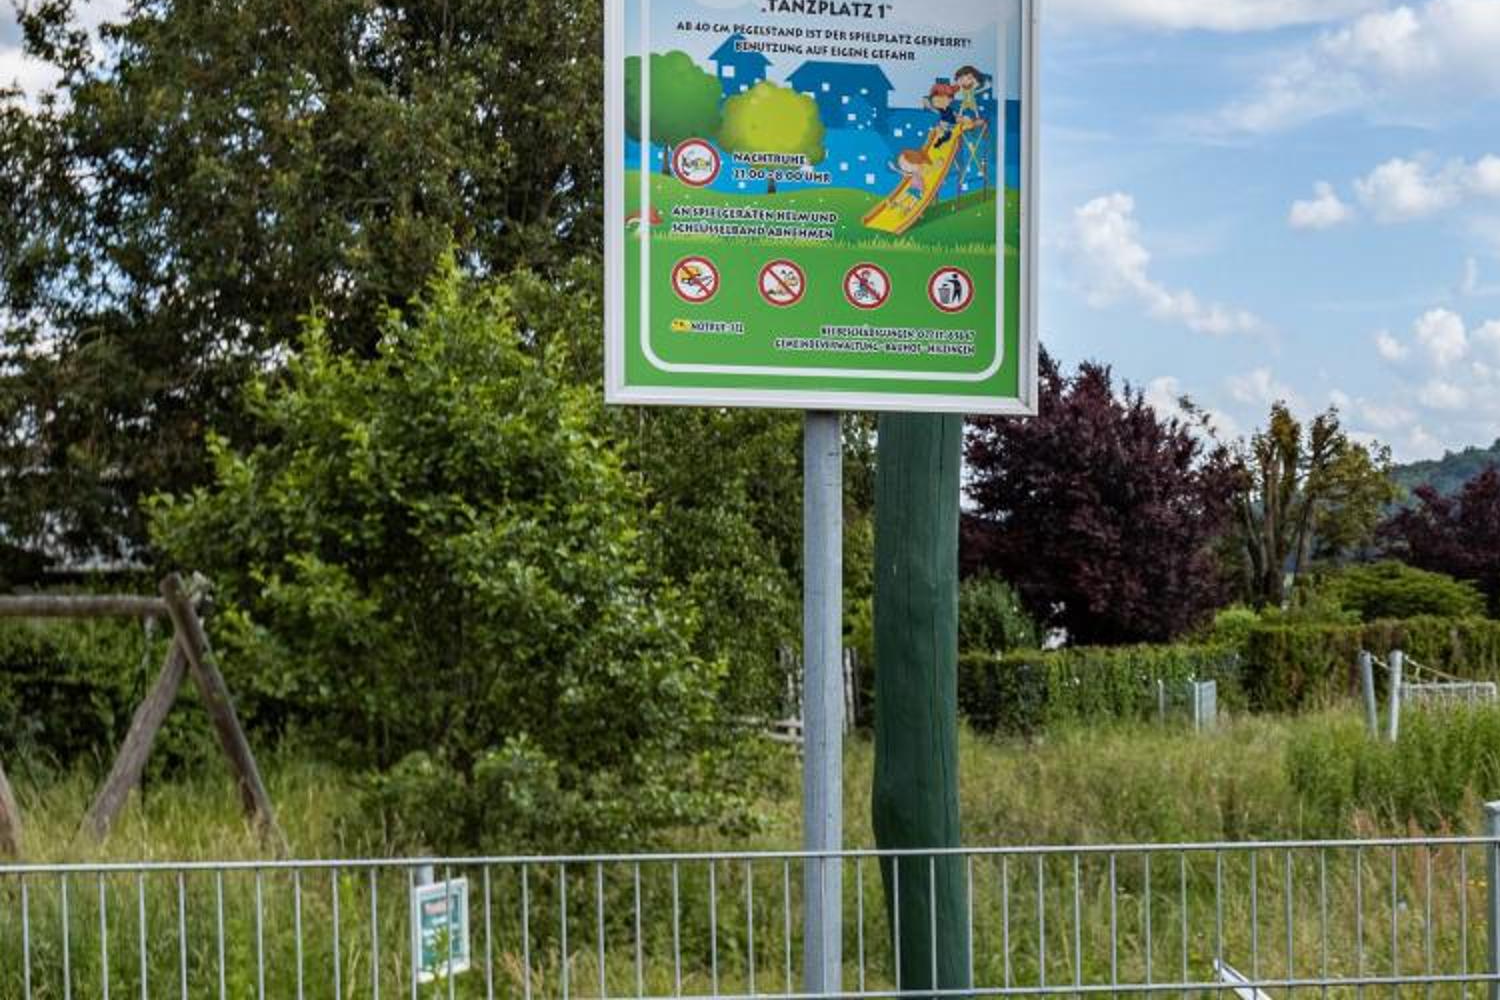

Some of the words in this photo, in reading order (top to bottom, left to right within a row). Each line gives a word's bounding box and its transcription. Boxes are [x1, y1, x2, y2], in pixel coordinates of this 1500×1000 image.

[677, 21, 692, 31] AB
[713, 23, 730, 33] CM
[733, 24, 803, 38] PEGELSTAND
[805, 29, 822, 39] IST
[825, 29, 847, 41] DER
[849, 31, 911, 45] SPIELPLATZ
[735, 42, 803, 55] BENUTZUNG
[806, 45, 828, 56] AUF
[831, 46, 869, 59] EIGENE
[871, 50, 915, 61] GEFAHR
[733, 152, 806, 165] NACHTRUHE
[805, 171, 831, 185] UHR
[768, 227, 833, 239] ABNEHMEN
